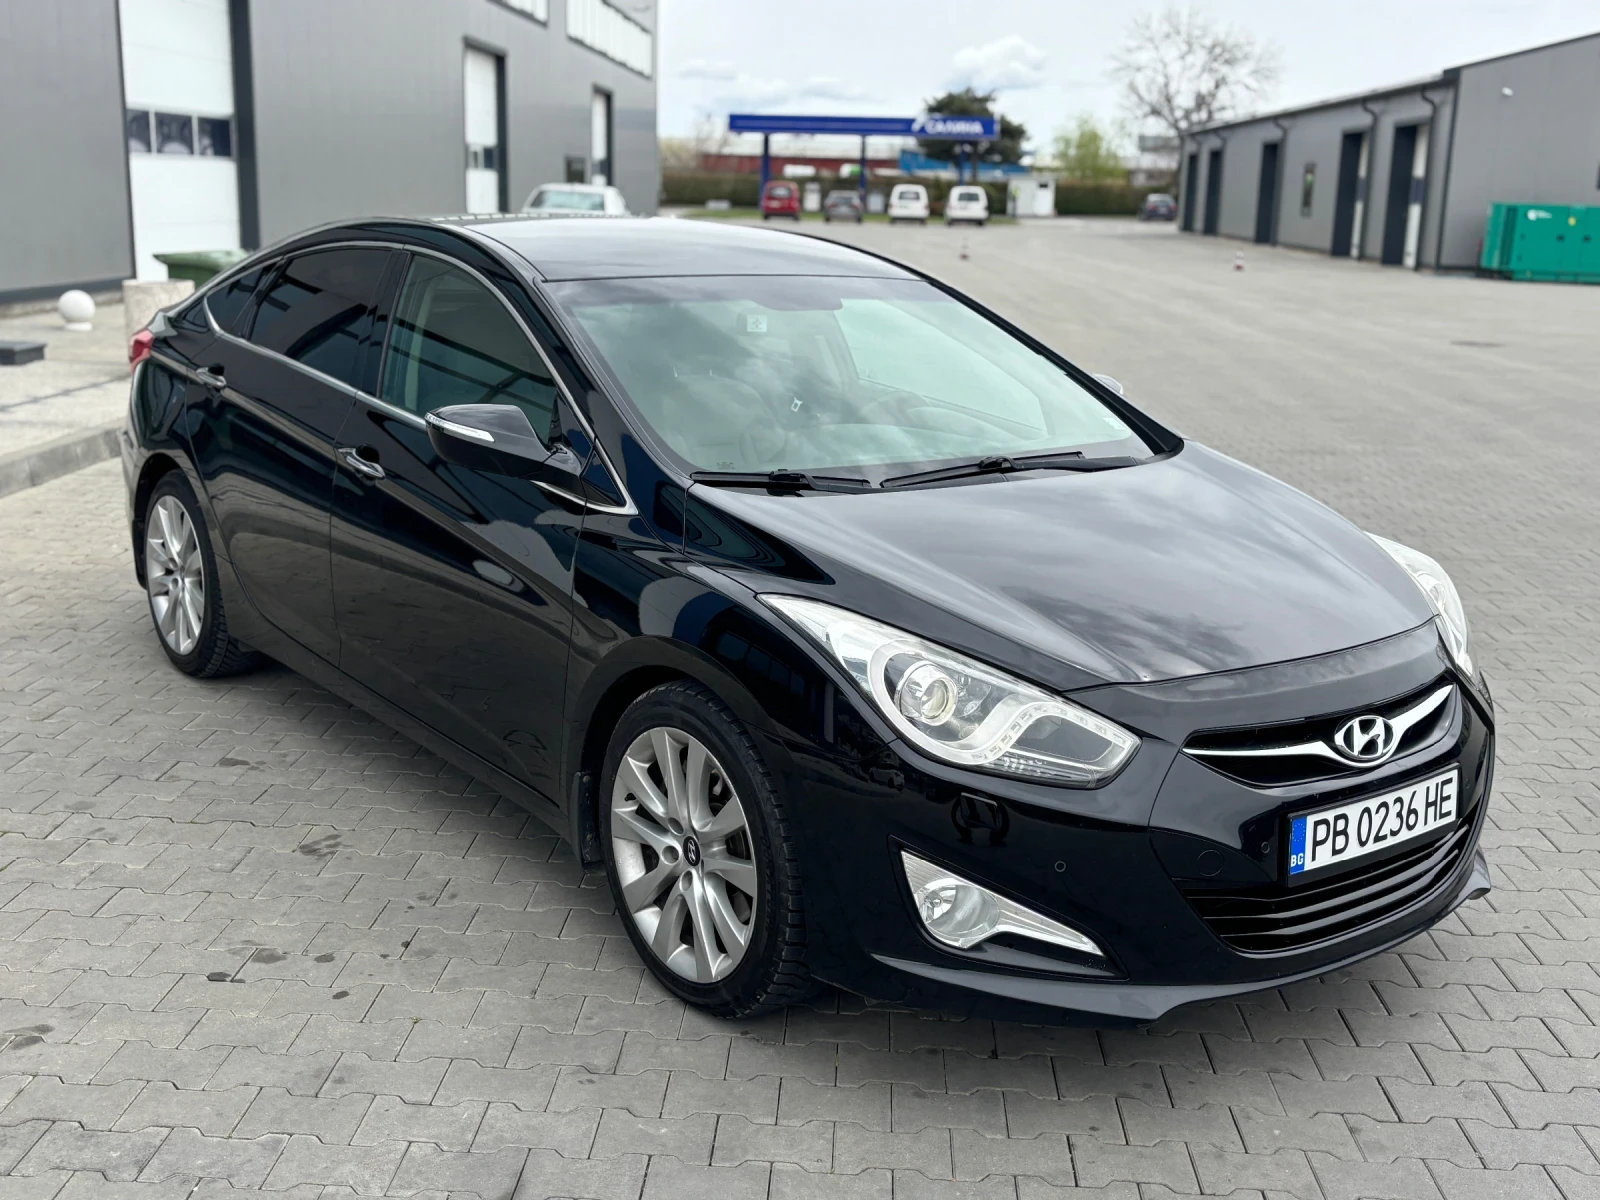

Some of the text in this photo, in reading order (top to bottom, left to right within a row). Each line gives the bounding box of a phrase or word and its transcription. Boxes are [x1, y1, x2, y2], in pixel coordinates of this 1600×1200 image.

[1311, 776, 1454, 862] PB 0236 HE
[1290, 852, 1304, 867] BG
